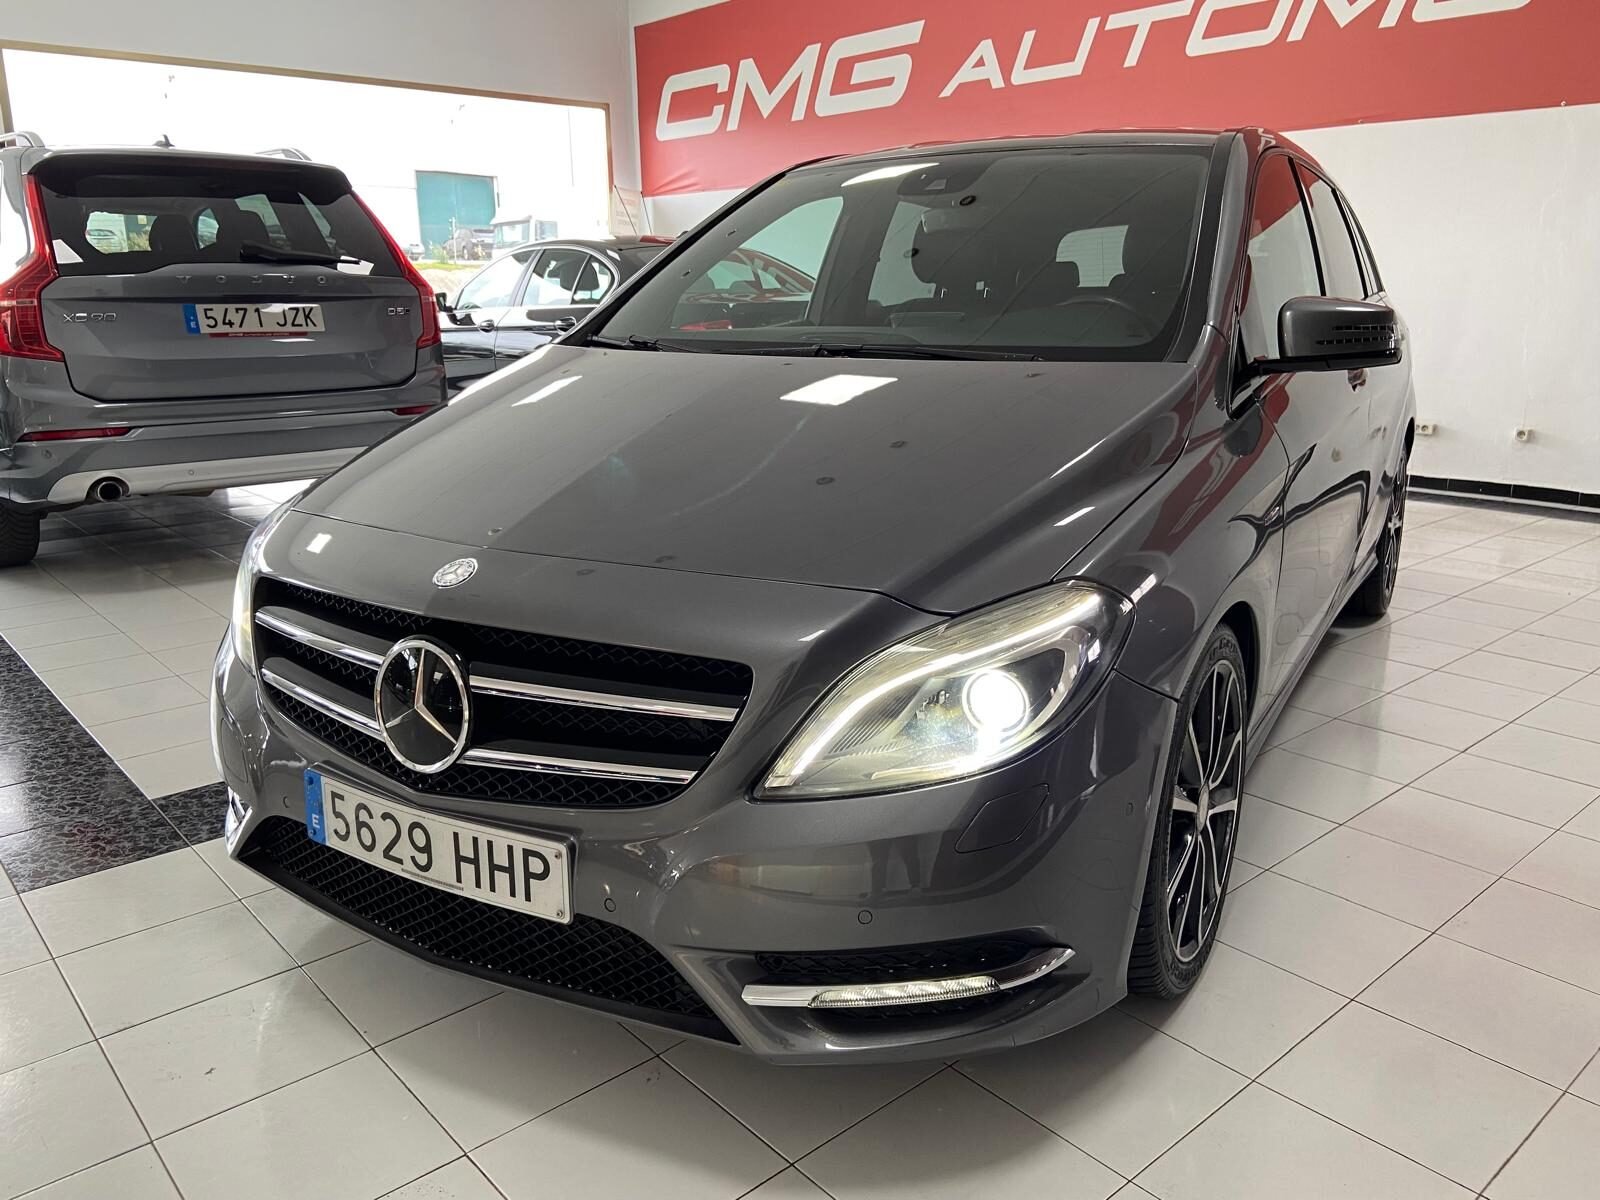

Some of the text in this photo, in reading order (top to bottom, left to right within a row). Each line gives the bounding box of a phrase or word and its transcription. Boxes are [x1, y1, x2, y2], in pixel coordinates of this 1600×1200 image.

[655, 19, 927, 142] CMG
[203, 306, 317, 329] 5471 JZK
[311, 814, 321, 829] E
[330, 790, 551, 903] 5629 HHP
